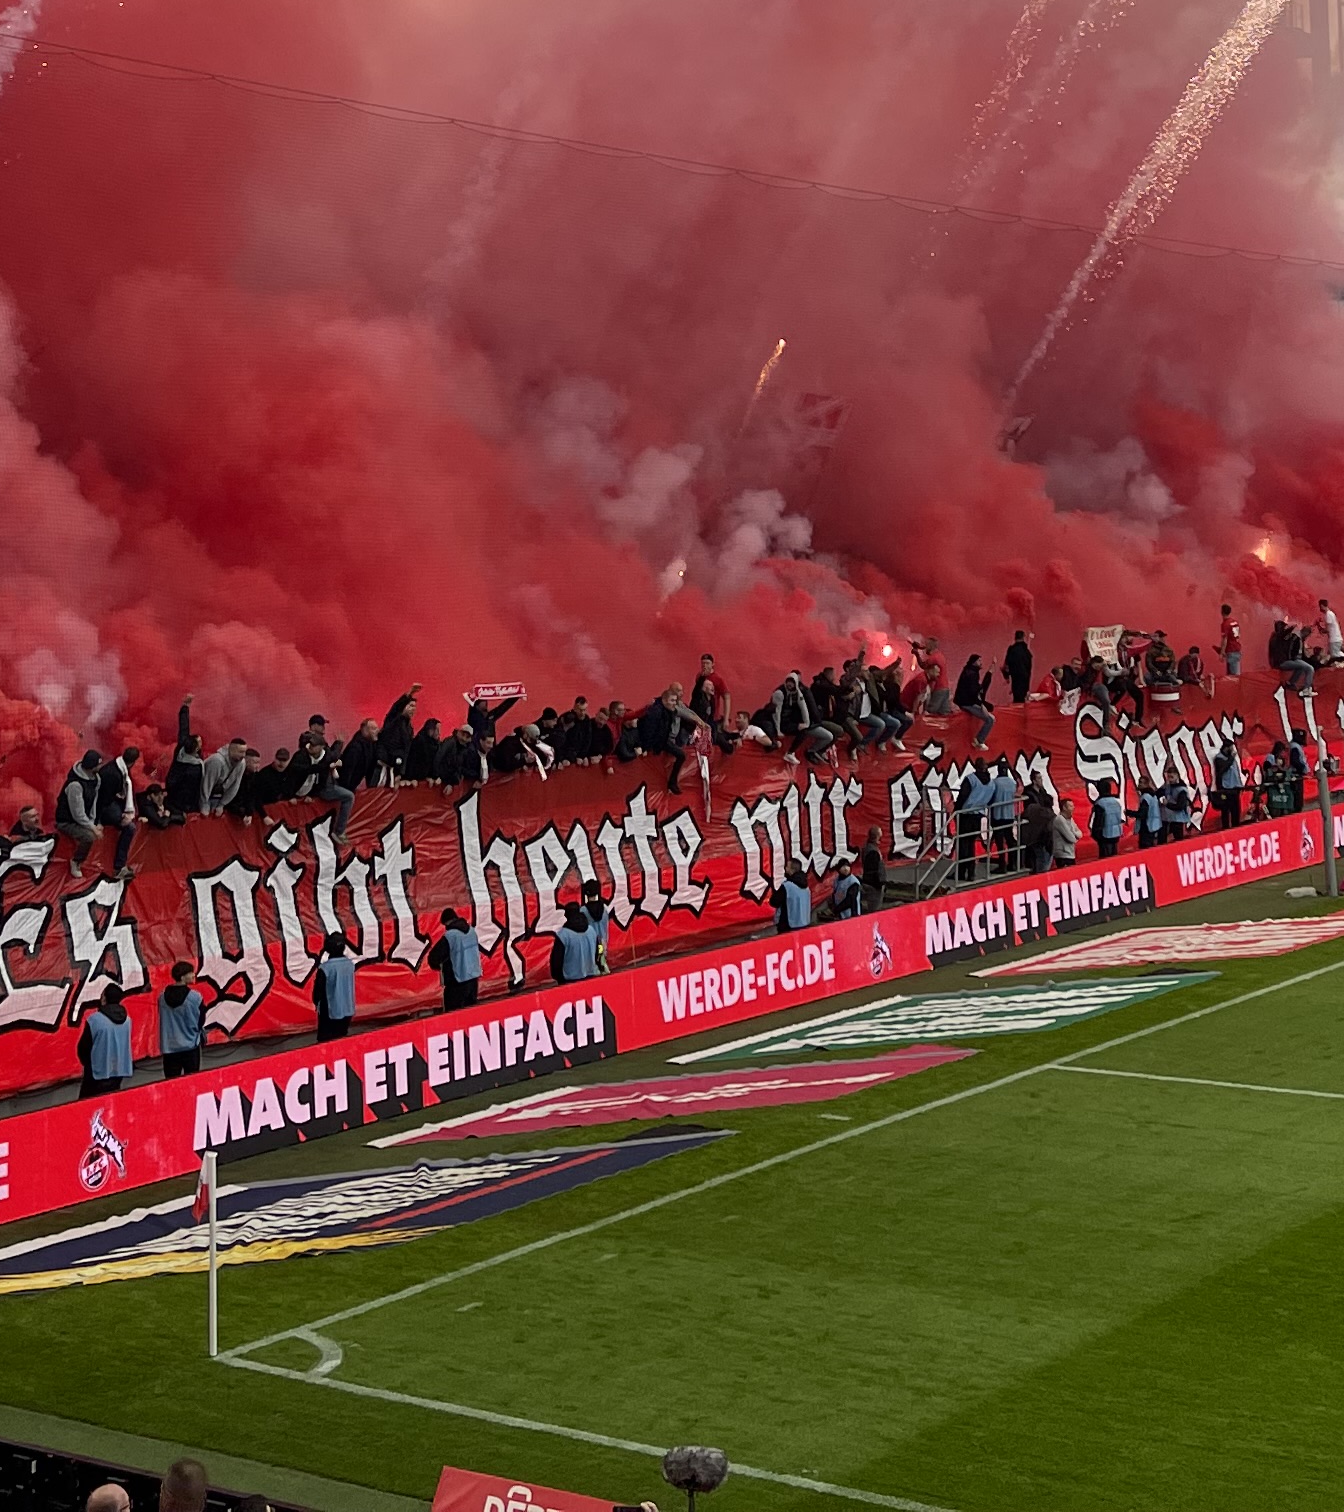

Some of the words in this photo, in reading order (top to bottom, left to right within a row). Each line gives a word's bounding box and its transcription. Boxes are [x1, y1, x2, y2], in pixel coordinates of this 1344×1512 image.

[190, 814, 431, 1035] gibt
[458, 782, 711, 988] heute
[731, 770, 864, 901] nur
[889, 742, 1061, 860] ein
[1176, 831, 1281, 887] WERDE-FC.DE
[925, 896, 1007, 955] MACH
[1012, 889, 1043, 932] ET
[1047, 864, 1149, 922] EINFACH
[657, 939, 836, 1023] WERDE-FC.DE
[192, 1058, 350, 1151] MACH
[364, 1043, 415, 1105] ET
[427, 995, 606, 1086] EINFACH
